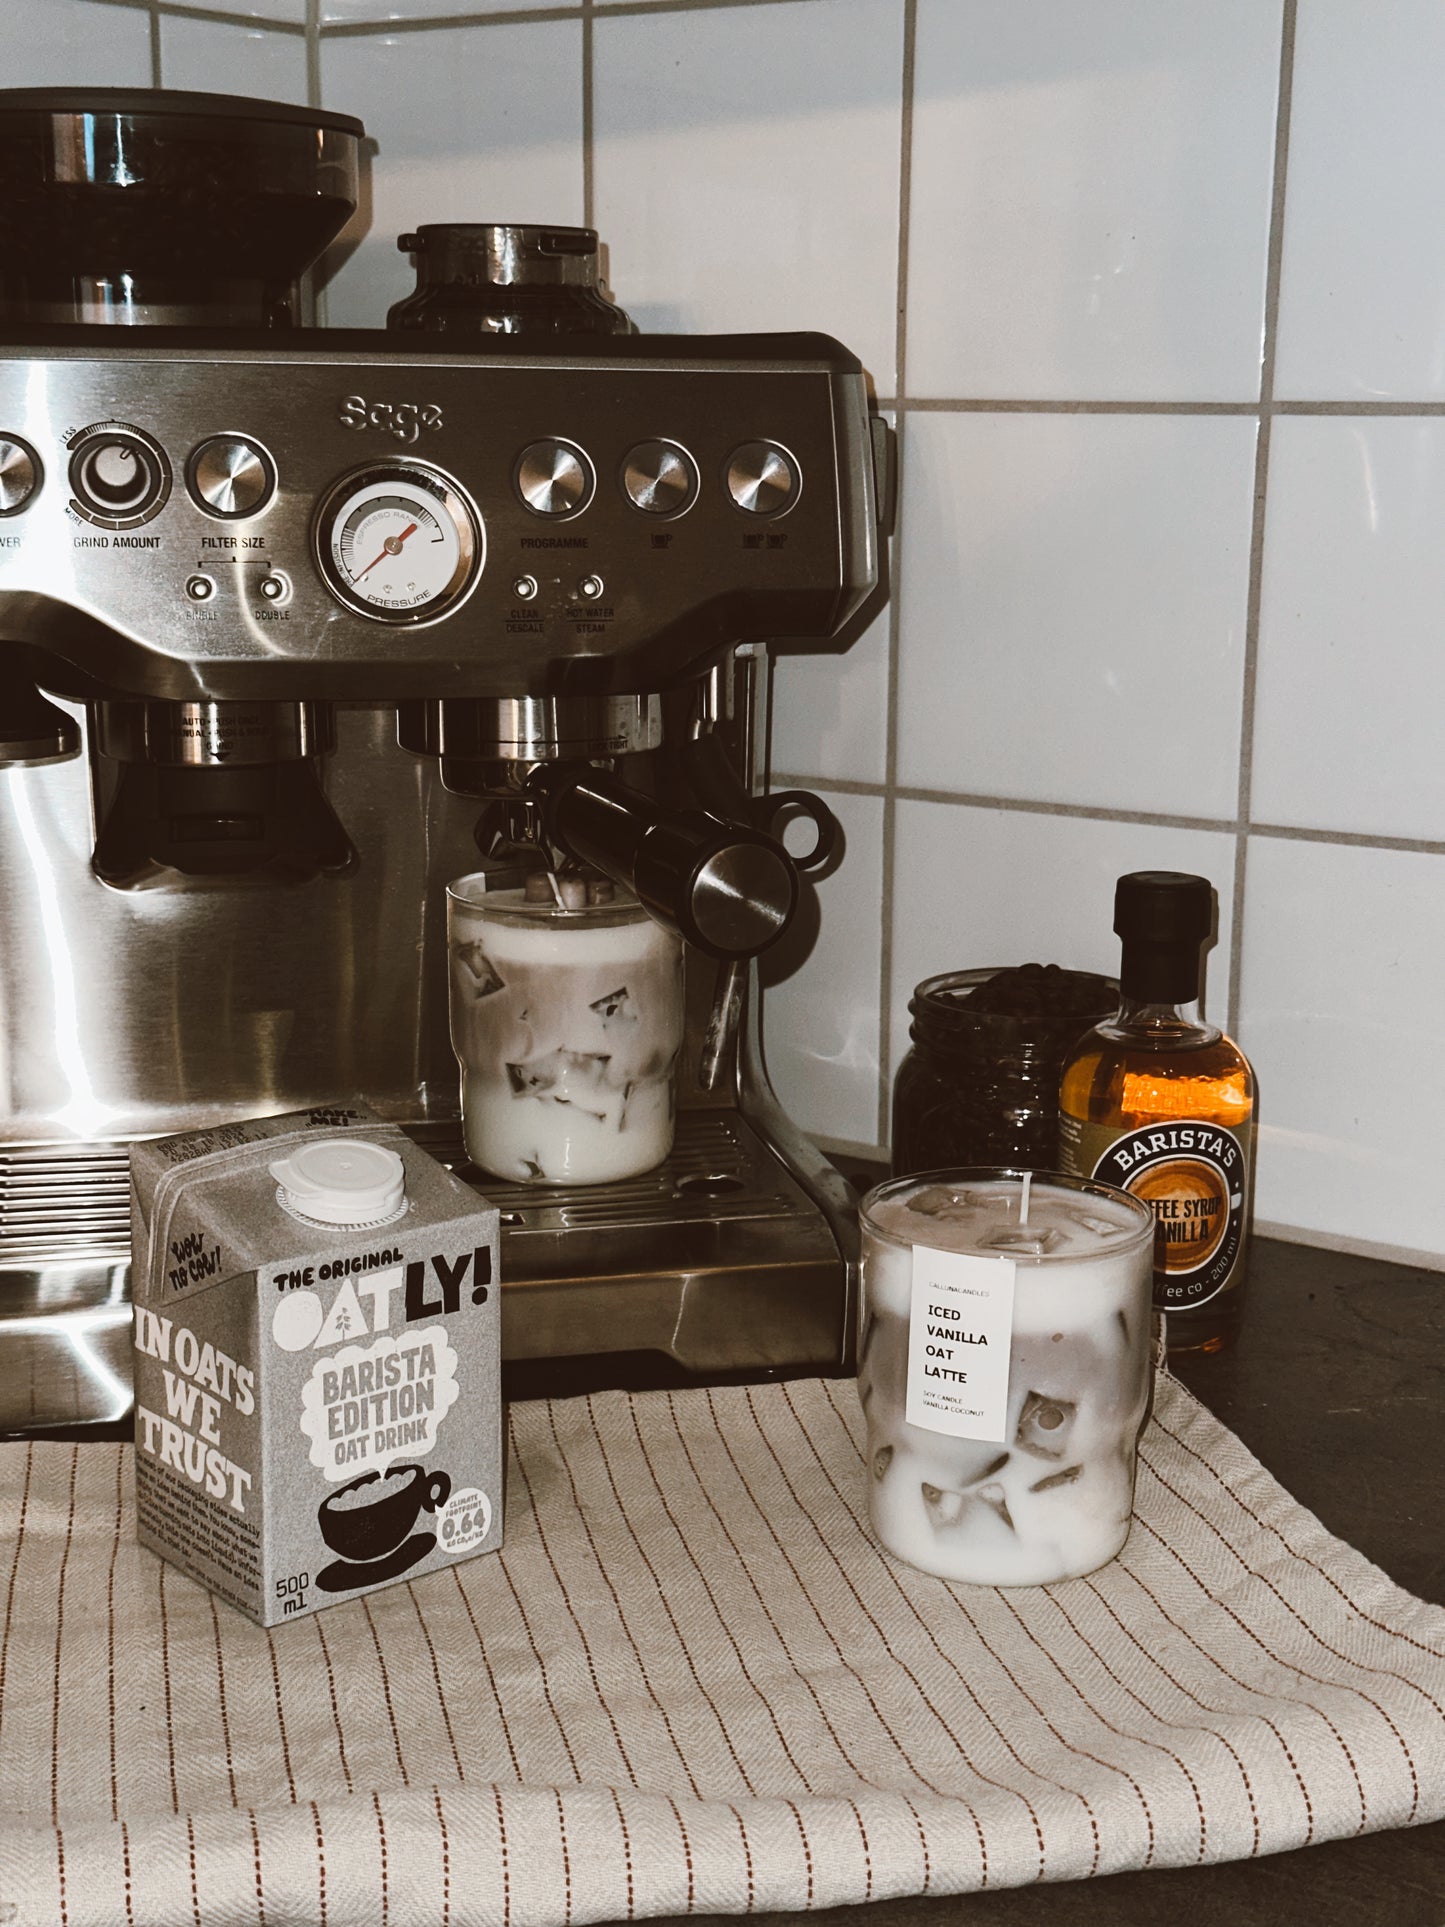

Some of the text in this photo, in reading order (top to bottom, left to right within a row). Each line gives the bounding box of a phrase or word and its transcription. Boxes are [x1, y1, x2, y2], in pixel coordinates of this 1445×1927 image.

[340, 396, 443, 443] Sage
[74, 537, 160, 548] GRIND AMOUNT
[202, 537, 265, 548] FILTER SIZE
[521, 538, 588, 549] PROGRAMME
[366, 589, 431, 608] PRESSURE
[255, 611, 290, 621] DOUBLE
[587, 607, 614, 618] WATER
[506, 624, 544, 633] DESCALE
[576, 624, 605, 633] STEAM
[1113, 1130, 1237, 1170] BARISTA'S
[1147, 1199, 1179, 1219] FFEE
[1156, 1219, 1209, 1243] ANILLA
[273, 1248, 404, 1292] THE ORIGINAL
[1188, 1282, 1203, 1295] co
[1211, 1256, 1229, 1280] 200
[1227, 1237, 1237, 1255] ml
[928, 1304, 961, 1321] ICED
[927, 1324, 988, 1346] VANILLA
[134, 1306, 255, 1416] IN OATS
[925, 1345, 955, 1360] OAT
[322, 1343, 437, 1406] BARISTA
[924, 1364, 968, 1383] LATTE
[162, 1369, 222, 1446] WE
[327, 1379, 435, 1440] EDITION
[923, 1400, 985, 1417] VANILLA COCONUT
[937, 1394, 962, 1404] CANDLE
[334, 1417, 429, 1466] OAT DRINK
[138, 1405, 252, 1513] TRUST
[442, 1508, 485, 1540] 0.64
[276, 1572, 310, 1599] 500
[284, 1592, 308, 1615] ml
